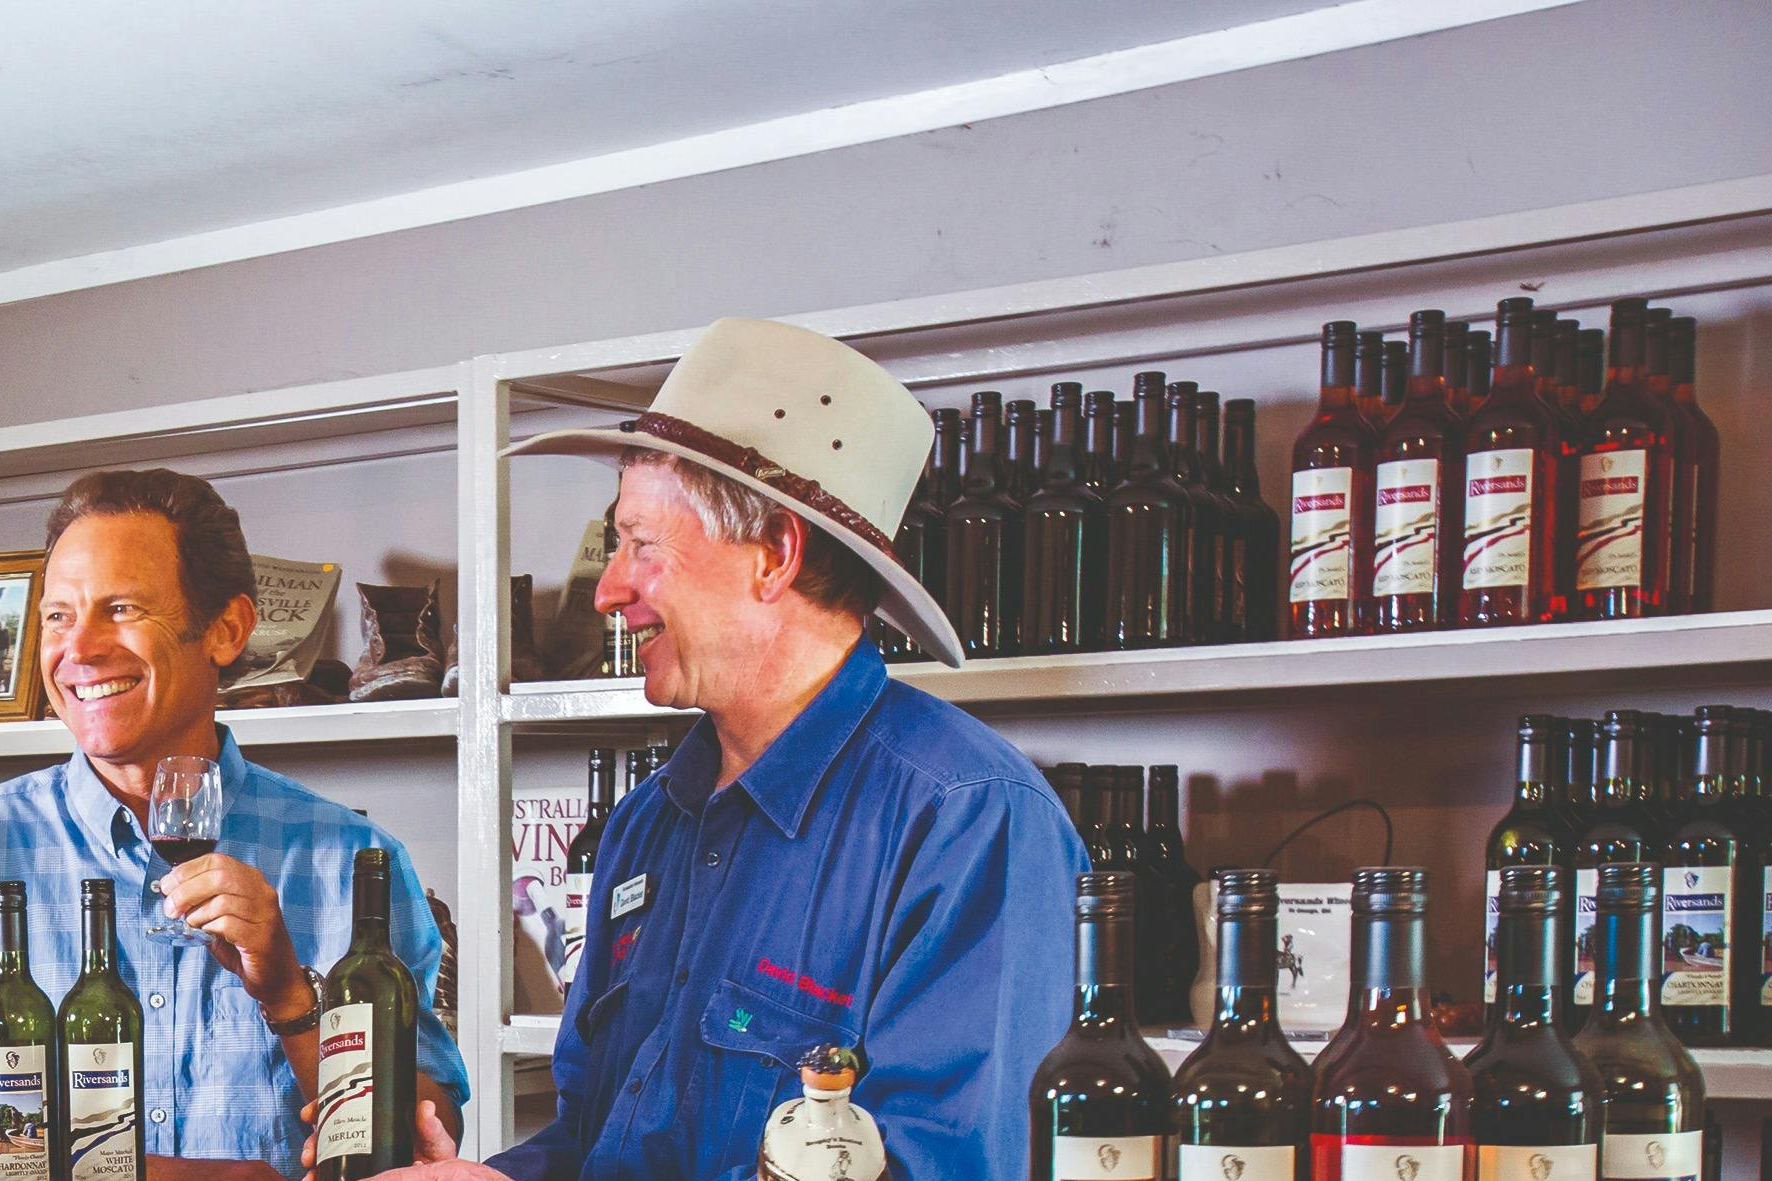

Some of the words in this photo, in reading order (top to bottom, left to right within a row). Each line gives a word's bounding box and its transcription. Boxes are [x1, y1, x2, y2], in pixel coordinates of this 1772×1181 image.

[1470, 477, 1526, 497] Riversands
[257, 574, 324, 591] ILMAN
[1665, 894, 1723, 912] Riversands
[73, 1070, 128, 1088] Riversands
[328, 1130, 366, 1142] MERLOT
[106, 1155, 133, 1165] WHITE
[92, 1164, 134, 1174] MOSCATO
